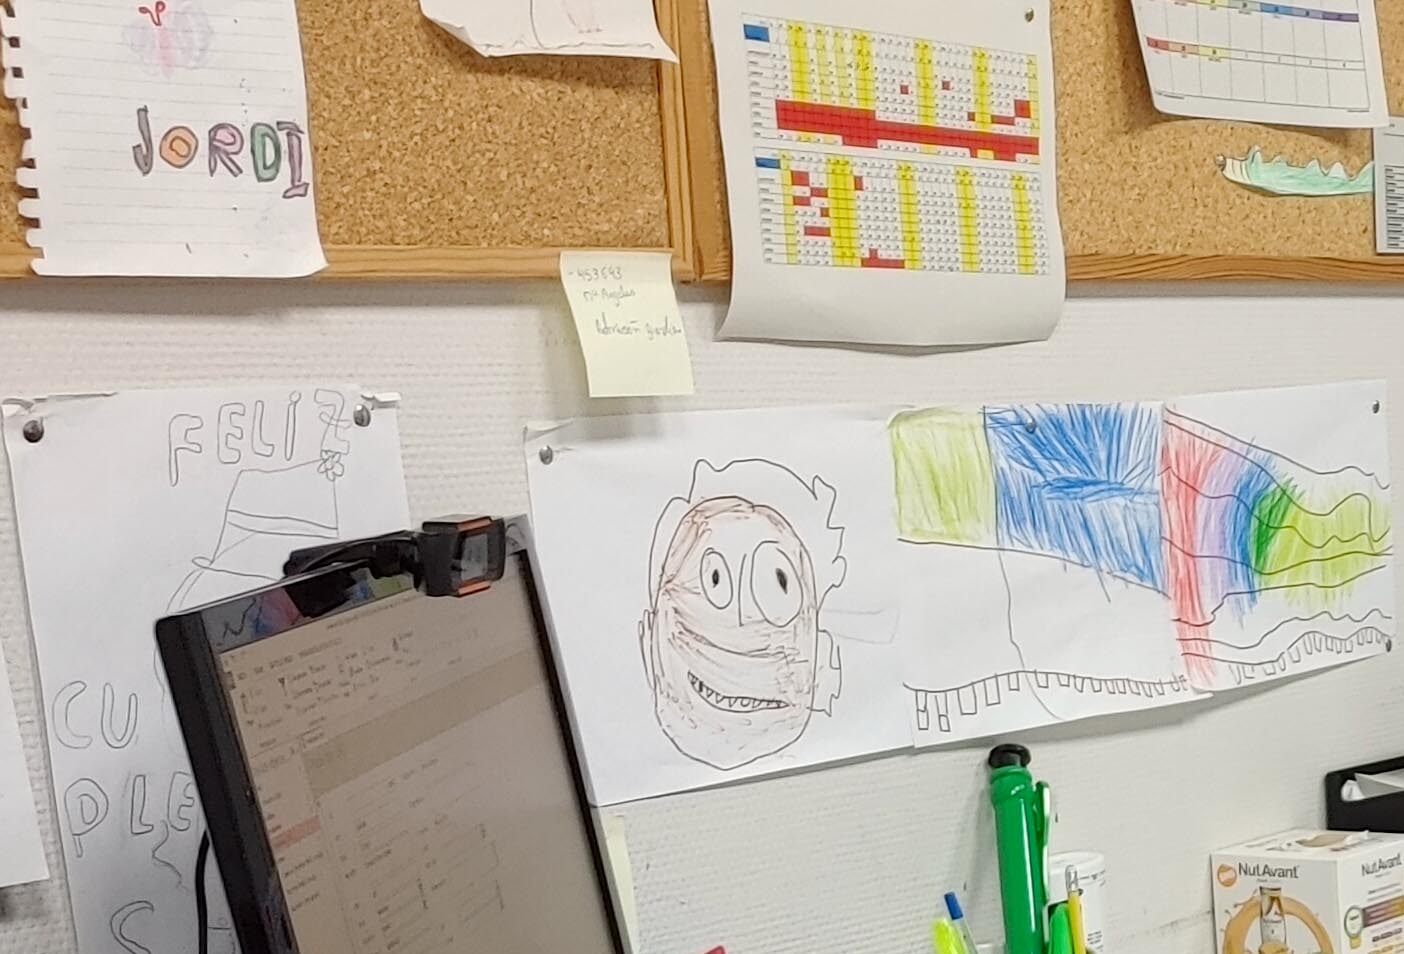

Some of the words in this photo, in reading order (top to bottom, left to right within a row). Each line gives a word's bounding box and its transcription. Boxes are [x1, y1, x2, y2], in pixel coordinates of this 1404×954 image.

[132, 104, 309, 198] JORDI
[168, 388, 352, 486] FELIZ
[51, 680, 138, 750] CU
[1238, 862, 1300, 880] NutAvant
